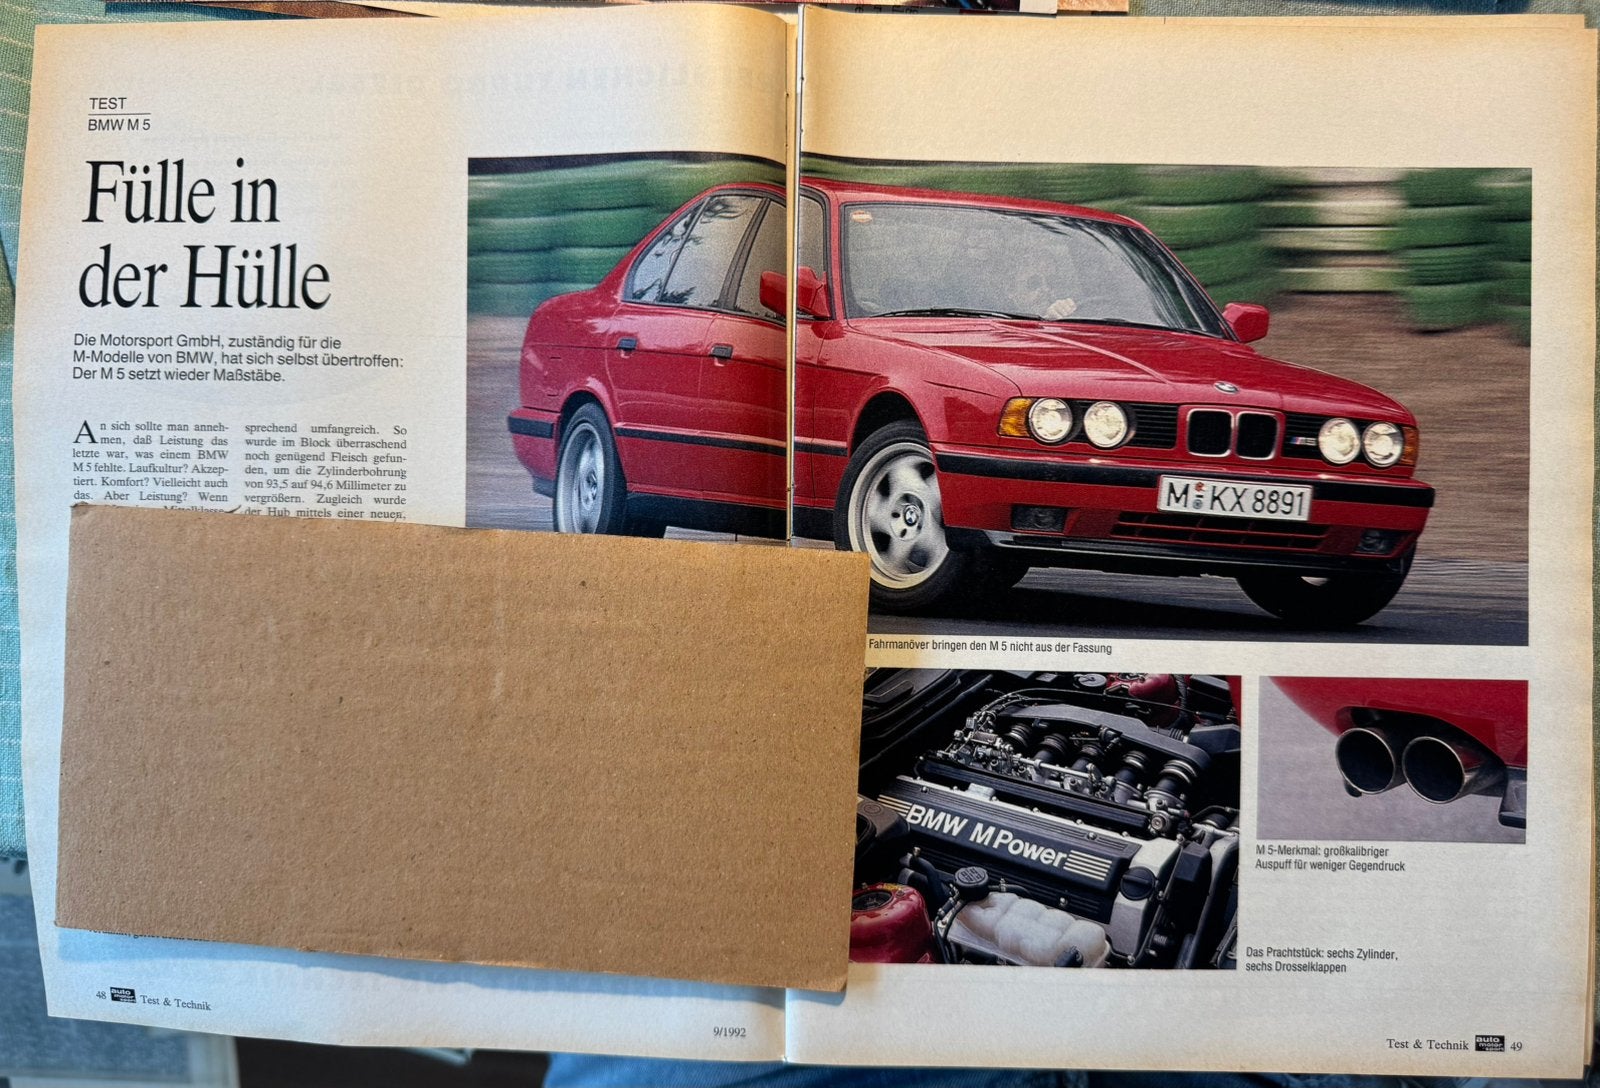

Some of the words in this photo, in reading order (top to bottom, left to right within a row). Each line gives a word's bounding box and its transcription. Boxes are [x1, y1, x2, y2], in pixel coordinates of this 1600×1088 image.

[89, 97, 127, 110] TEST
[88, 119, 124, 131] BMW
[127, 119, 140, 131] M
[142, 118, 151, 131] 5
[82, 158, 216, 224] Fülle
[230, 157, 281, 223] in
[79, 243, 168, 308] der
[180, 243, 331, 310] Hülle
[74, 333, 96, 346] Die
[99, 334, 173, 350] Motorsport
[176, 334, 225, 349] GmbH,
[228, 335, 294, 351] zuständig
[298, 335, 317, 349] für
[320, 336, 341, 349] die
[73, 350, 145, 364] M-Modelle
[147, 354, 173, 364] von
[176, 351, 217, 367] BMW,
[221, 351, 243, 365] hat
[246, 351, 274, 365] sich
[277, 352, 319, 366] selbst
[322, 352, 404, 368] übertroffen:
[72, 367, 98, 380] Der
[100, 367, 113, 380] M
[116, 368, 126, 380] 5
[128, 368, 161, 381] setzt
[164, 368, 210, 381] wieder
[213, 369, 286, 382] Maßstäbe.
[111, 421, 130, 431] sich
[135, 421, 163, 431] sollte
[167, 423, 189, 432] man
[194, 422, 229, 432] anneh-
[245, 423, 298, 436] sprechend
[311, 424, 380, 436] umfangreich.
[393, 425, 407, 435] So
[100, 436, 126, 446] men,
[133, 435, 153, 445] daß
[160, 435, 204, 447] Leistung
[211, 436, 229, 446] das
[245, 437, 277, 447] wurde
[282, 437, 295, 447] im
[301, 437, 331, 448] Block
[336, 438, 407, 450] überraschend
[72, 448, 100, 459] letzte
[106, 450, 129, 460] war,
[135, 451, 154, 460] was
[160, 450, 191, 460] einem
[198, 450, 229, 460] BMW
[245, 451, 270, 461] noch
[275, 452, 326, 464] genügend
[331, 452, 368, 462] Fleisch
[373, 453, 407, 465] gefun-
[73, 462, 84, 472] M
[86, 462, 93, 472] 5
[94, 462, 127, 473] fehlte.
[129, 463, 189, 474] Laufkultur?
[192, 464, 229, 477] Akzep-
[245, 465, 268, 476] den,
[273, 467, 290, 476] um
[295, 465, 312, 475] die
[316, 466, 407, 479] Zylinderbohrung
[74, 476, 98, 487] tiert.
[101, 477, 150, 488] Komfort?
[153, 477, 202, 488] Vielleicht
[204, 477, 229, 488] auch
[245, 480, 264, 490] von
[266, 479, 289, 491] 93,5
[291, 479, 309, 490] auf
[310, 480, 334, 491] 94,6
[336, 480, 392, 491] Millimeter
[394, 482, 407, 491] zu
[74, 490, 94, 501] das.
[104, 491, 130, 501] Aber
[140, 491, 188, 504] Leistung?
[199, 492, 228, 502] Wenn
[245, 493, 305, 505] vergrößern.
[316, 494, 363, 506] Zugleich
[373, 495, 407, 505] wurde
[1166, 481, 1190, 508] M
[1210, 485, 1249, 513] KX
[1252, 489, 1304, 517] 8891
[267, 507, 291, 518] Hub
[296, 508, 332, 519] mittels
[337, 509, 365, 519] einer
[868, 639, 930, 650] Fahrmanöver
[932, 639, 967, 652] bringen
[969, 640, 987, 651] den
[989, 641, 999, 651] M
[1001, 641, 1007, 651] 5
[1010, 641, 1033, 652] nicht
[1035, 643, 1052, 653] aus
[1054, 642, 1070, 653] der
[1072, 642, 1112, 655] Fassung
[906, 804, 968, 837] BMW
[1255, 844, 1265, 855] M
[1267, 845, 1321, 856] 5-Merkmal:
[1323, 845, 1389, 858] großkalibriger
[1255, 858, 1291, 871] Auspuff
[1294, 859, 1307, 870] für
[1309, 860, 1347, 872] weniger
[1349, 860, 1405, 873] Gegendruck
[1246, 946, 1264, 957] Das
[1266, 946, 1325, 958] Prachtstück:
[1326, 947, 1354, 959] sechs
[1356, 948, 1399, 961] Zylinder,
[1245, 961, 1273, 971] sechs
[1274, 961, 1347, 974] Drosselklappen
[96, 990, 107, 1000] 48
[140, 995, 160, 1005] Test
[163, 997, 172, 1006] &
[174, 998, 212, 1011] Technik
[713, 1026, 747, 1037] 9/1992
[1386, 1038, 1409, 1049] Test
[1413, 1039, 1422, 1049] &
[1427, 1039, 1469, 1050] Technik
[1510, 1041, 1523, 1051] 49
